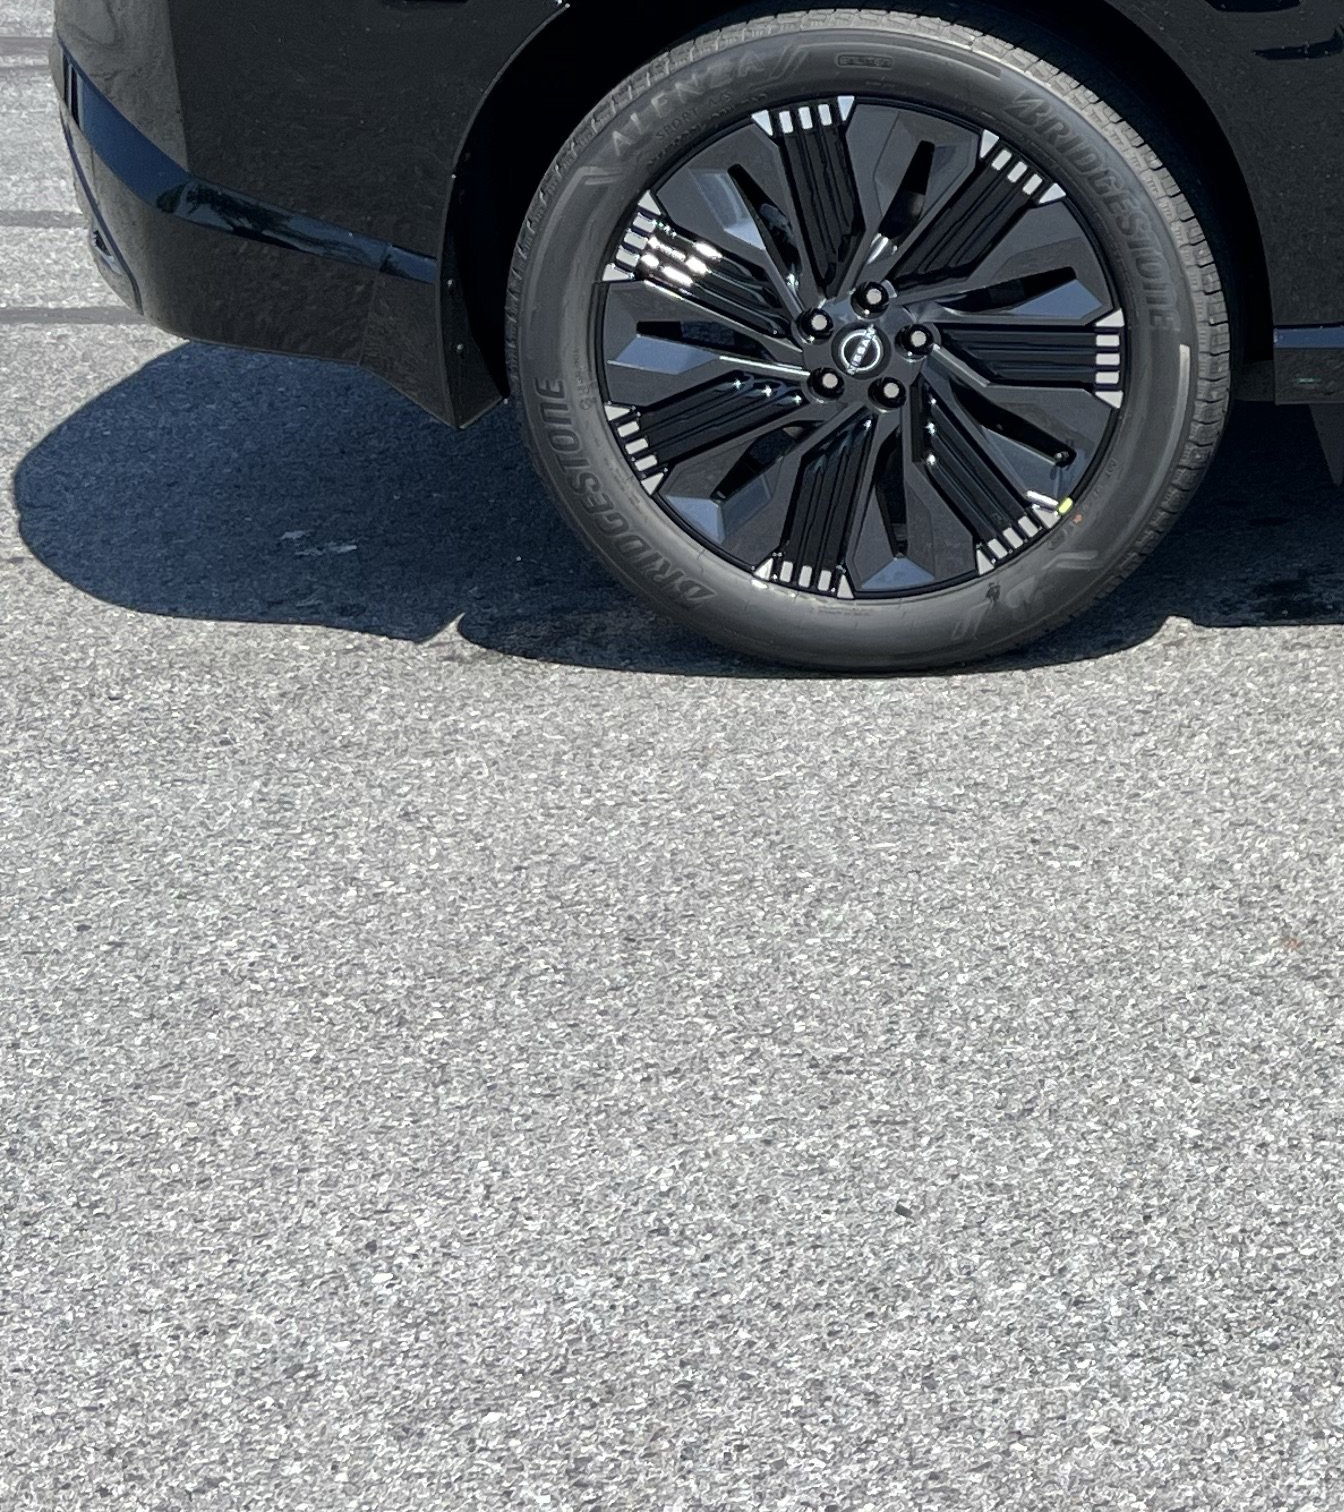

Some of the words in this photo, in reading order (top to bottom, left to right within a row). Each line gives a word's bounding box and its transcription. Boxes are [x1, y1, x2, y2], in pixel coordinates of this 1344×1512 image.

[1003, 90, 1181, 333] BRIDGESTONE
[847, 324, 876, 375] NISSAN
[535, 378, 717, 602] BRIDGESTONE
